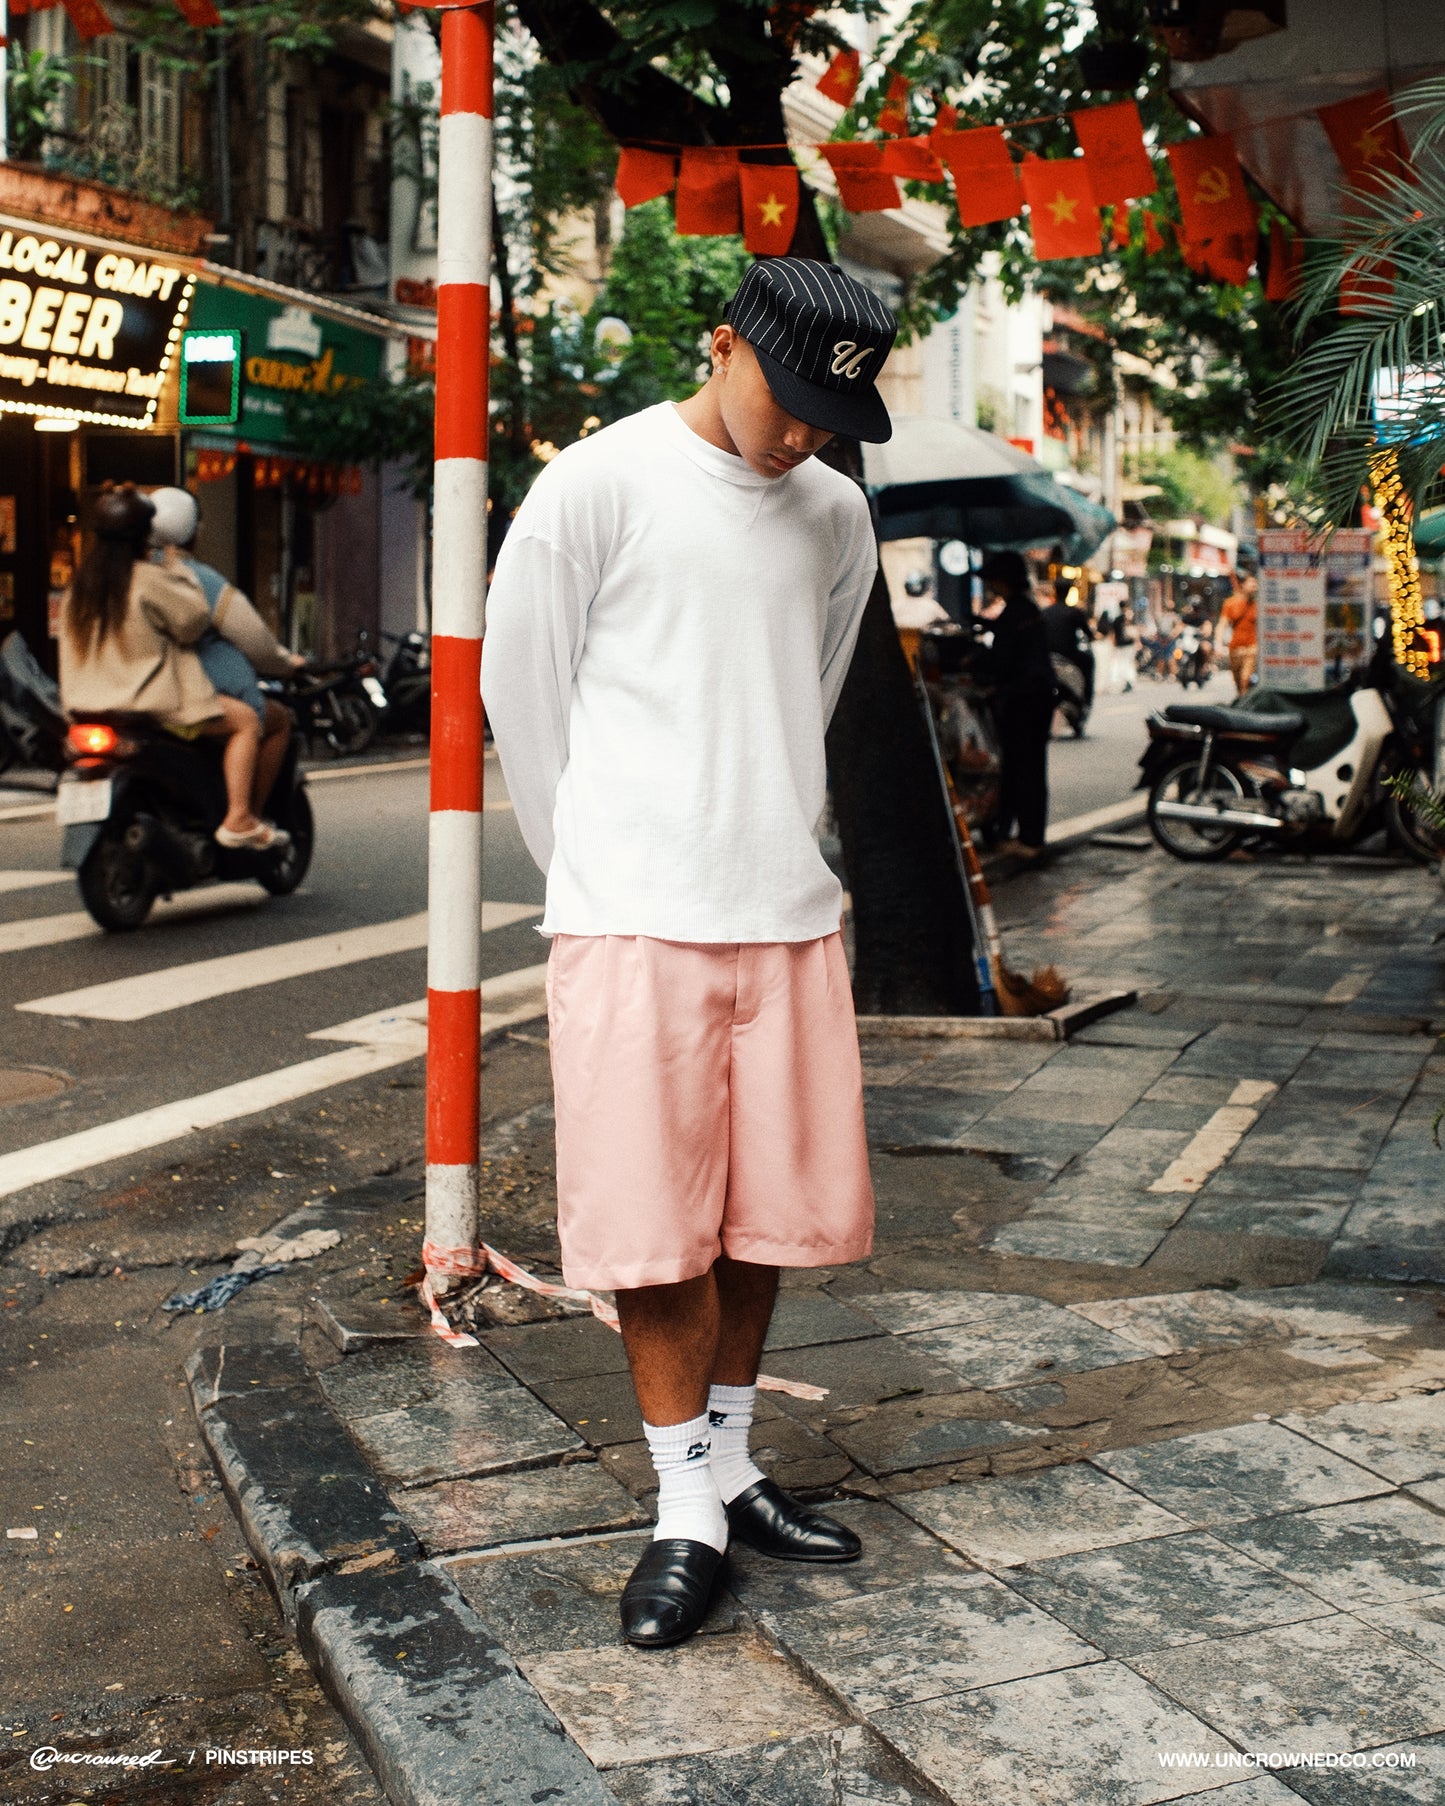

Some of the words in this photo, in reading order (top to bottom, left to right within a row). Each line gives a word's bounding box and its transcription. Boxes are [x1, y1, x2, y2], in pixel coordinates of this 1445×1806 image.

[0, 231, 88, 284] LOCAL
[94, 254, 181, 301] CRAFT
[0, 279, 124, 360] BEER
